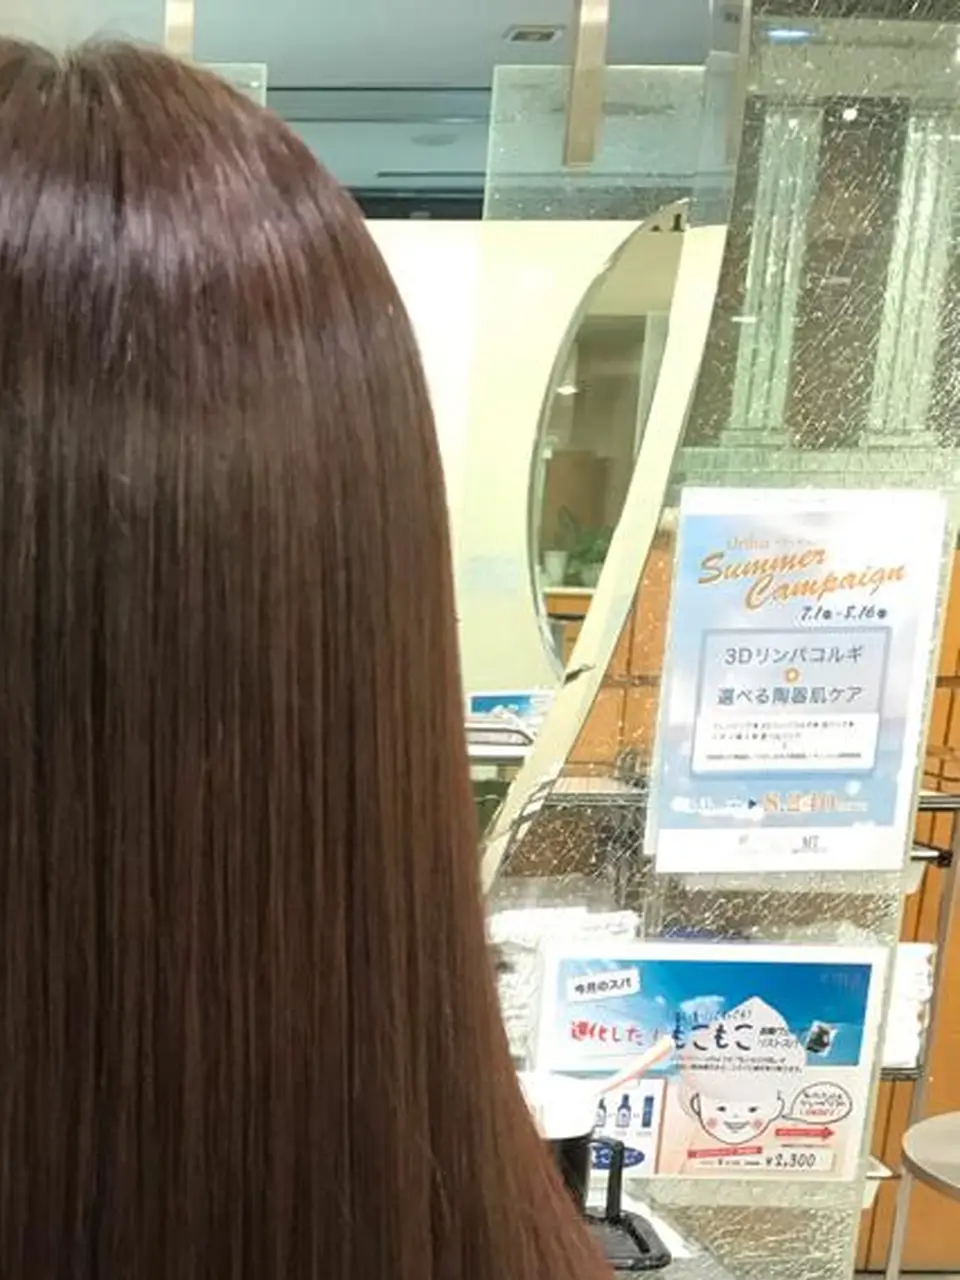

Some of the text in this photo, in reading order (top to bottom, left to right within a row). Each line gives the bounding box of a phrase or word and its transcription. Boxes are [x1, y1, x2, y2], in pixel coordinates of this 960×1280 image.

[698, 548, 906, 610] Summer Campaign
[574, 977, 632, 995] 今月のスパ
